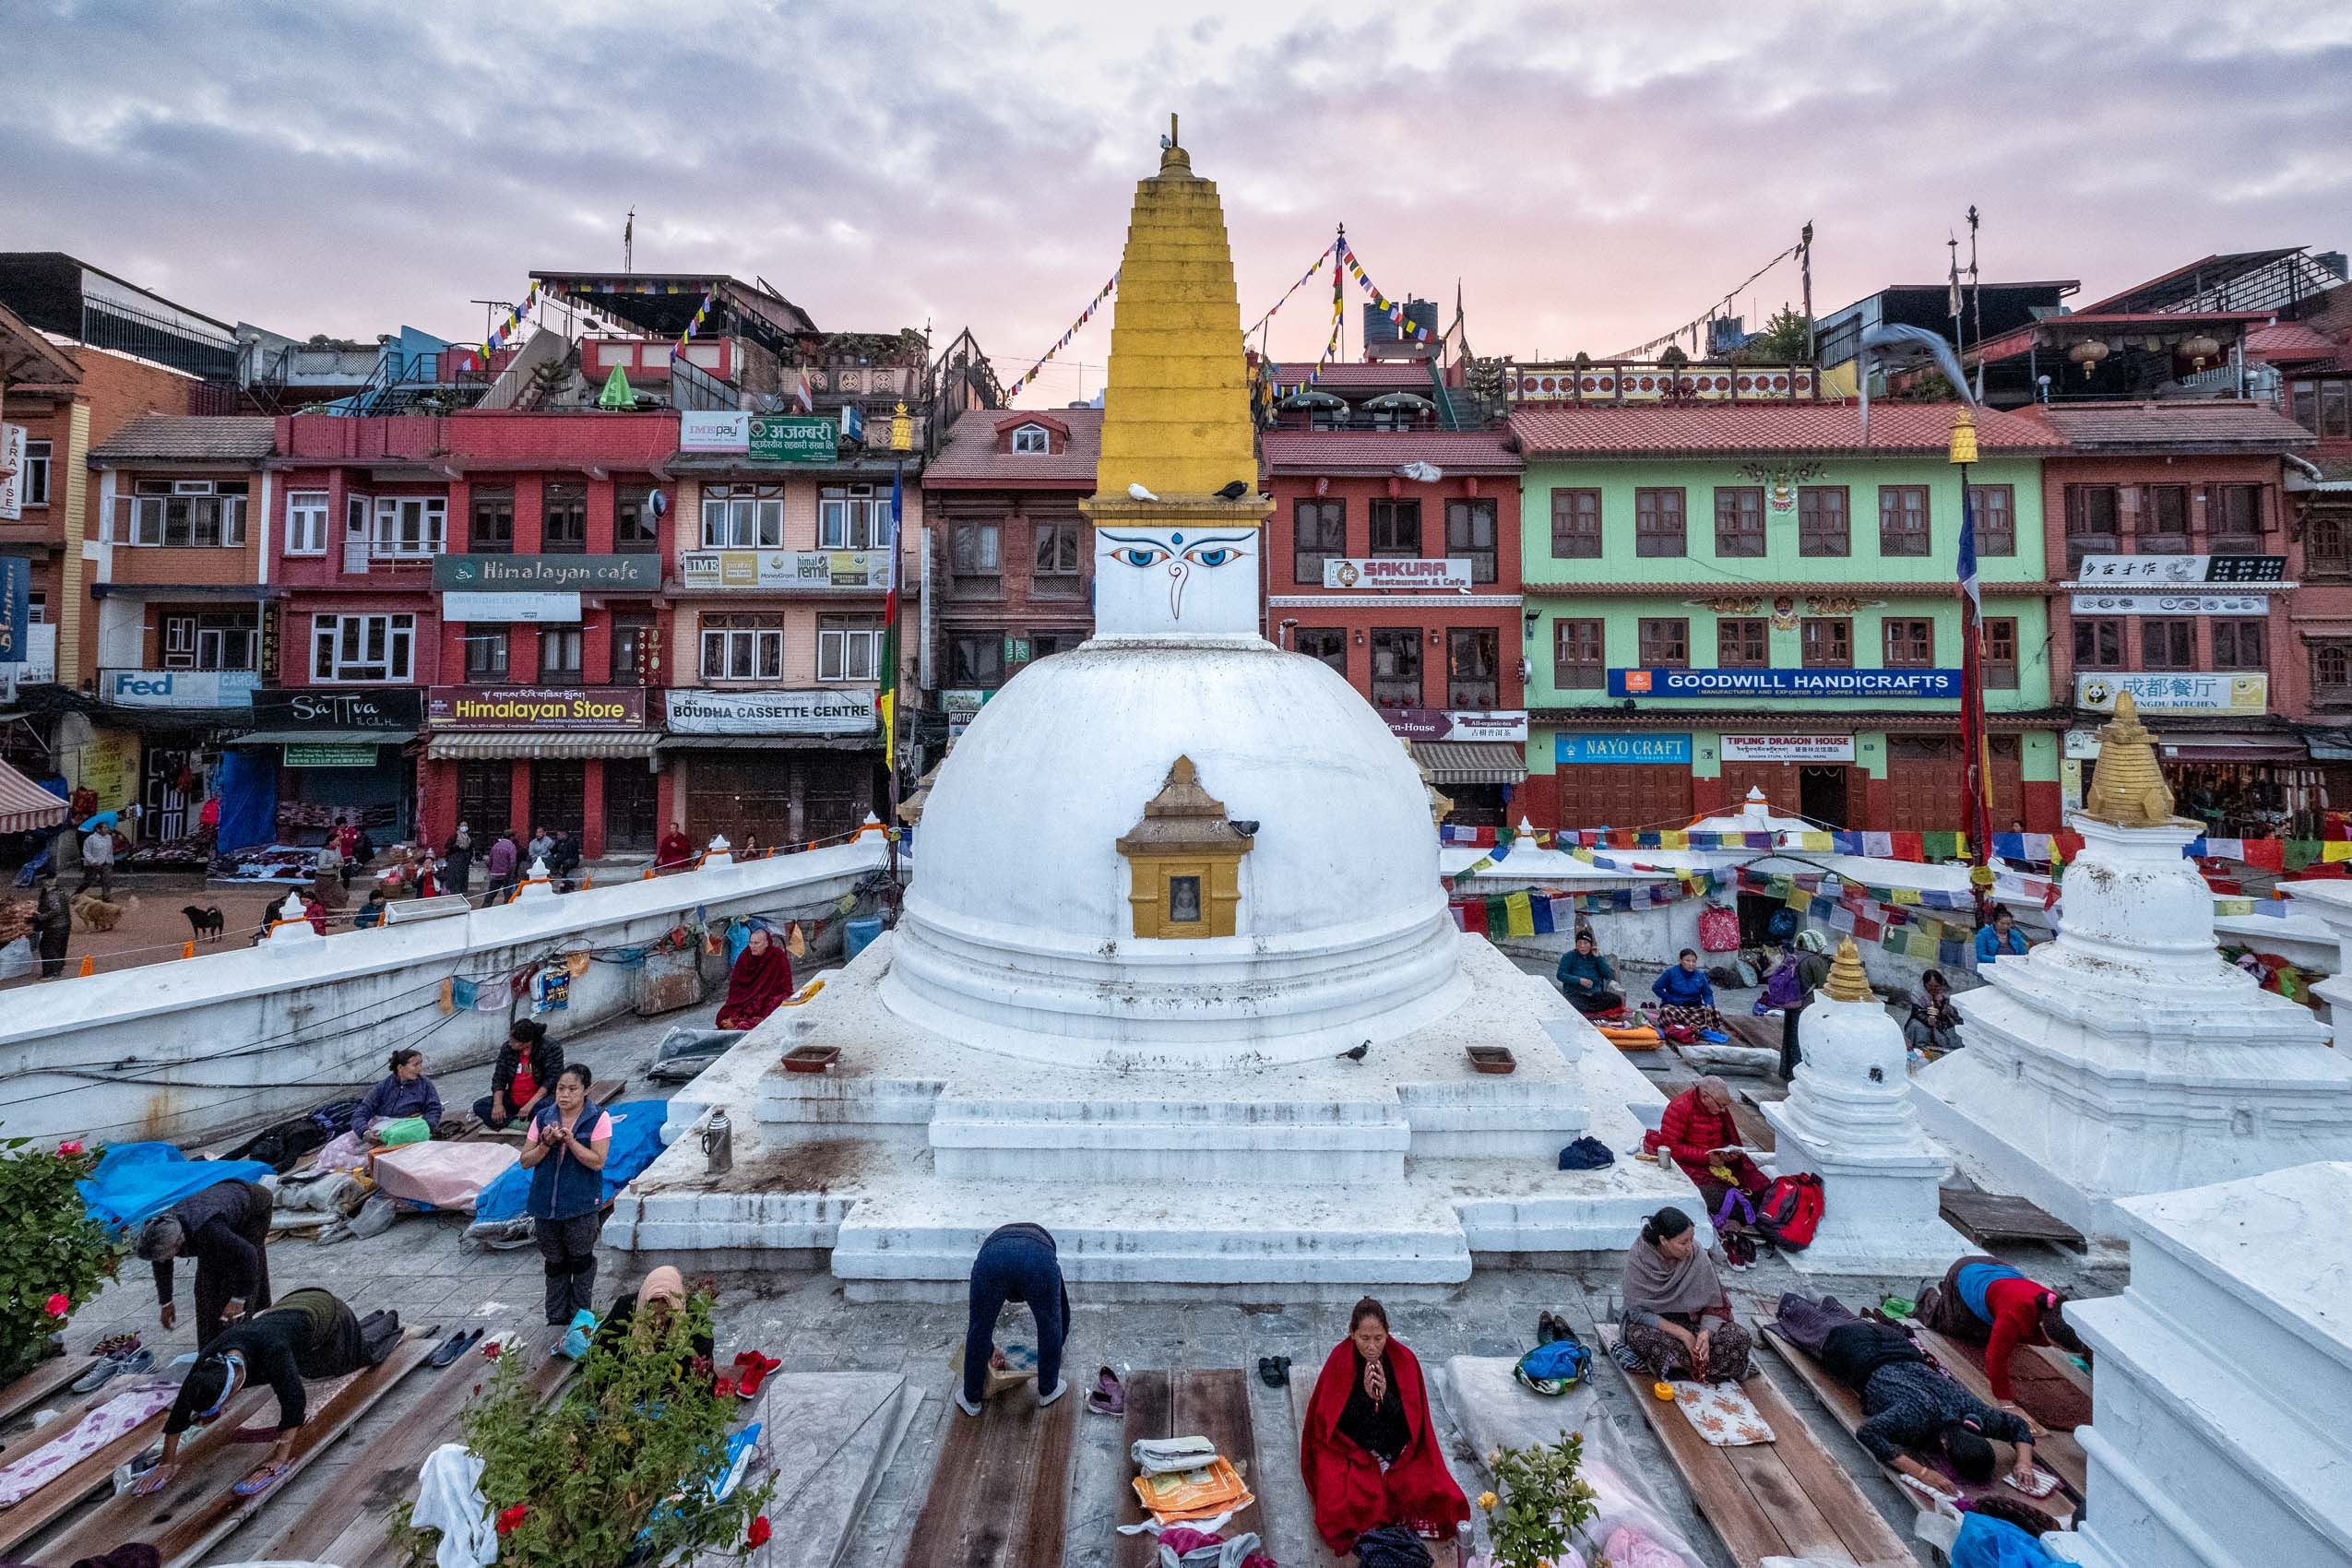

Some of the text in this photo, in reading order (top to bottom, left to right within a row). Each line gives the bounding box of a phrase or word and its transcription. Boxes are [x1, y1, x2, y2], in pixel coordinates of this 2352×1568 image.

[769, 422, 832, 441] अजम्बरी
[6, 428, 19, 506] PARAISE
[692, 559, 719, 572] IME
[797, 556, 817, 566] himal
[483, 561, 639, 584] Himalayan cafe
[797, 566, 829, 578] remit
[1364, 562, 1447, 576] SAKURA
[2083, 562, 2157, 576] 多吉手作
[1372, 577, 1429, 586] Restaurant
[1443, 577, 1467, 586] Cafe
[220, 674, 259, 687] CARG
[1668, 675, 1949, 688] GOODWILL HANDICRAFTS
[2123, 678, 2216, 698] 成都餐厅
[457, 700, 624, 721] Himalayan Store
[673, 705, 870, 719] BOUDHA CASSETTE CENTRE
[1586, 740, 1683, 754] NAYO CRAFT
